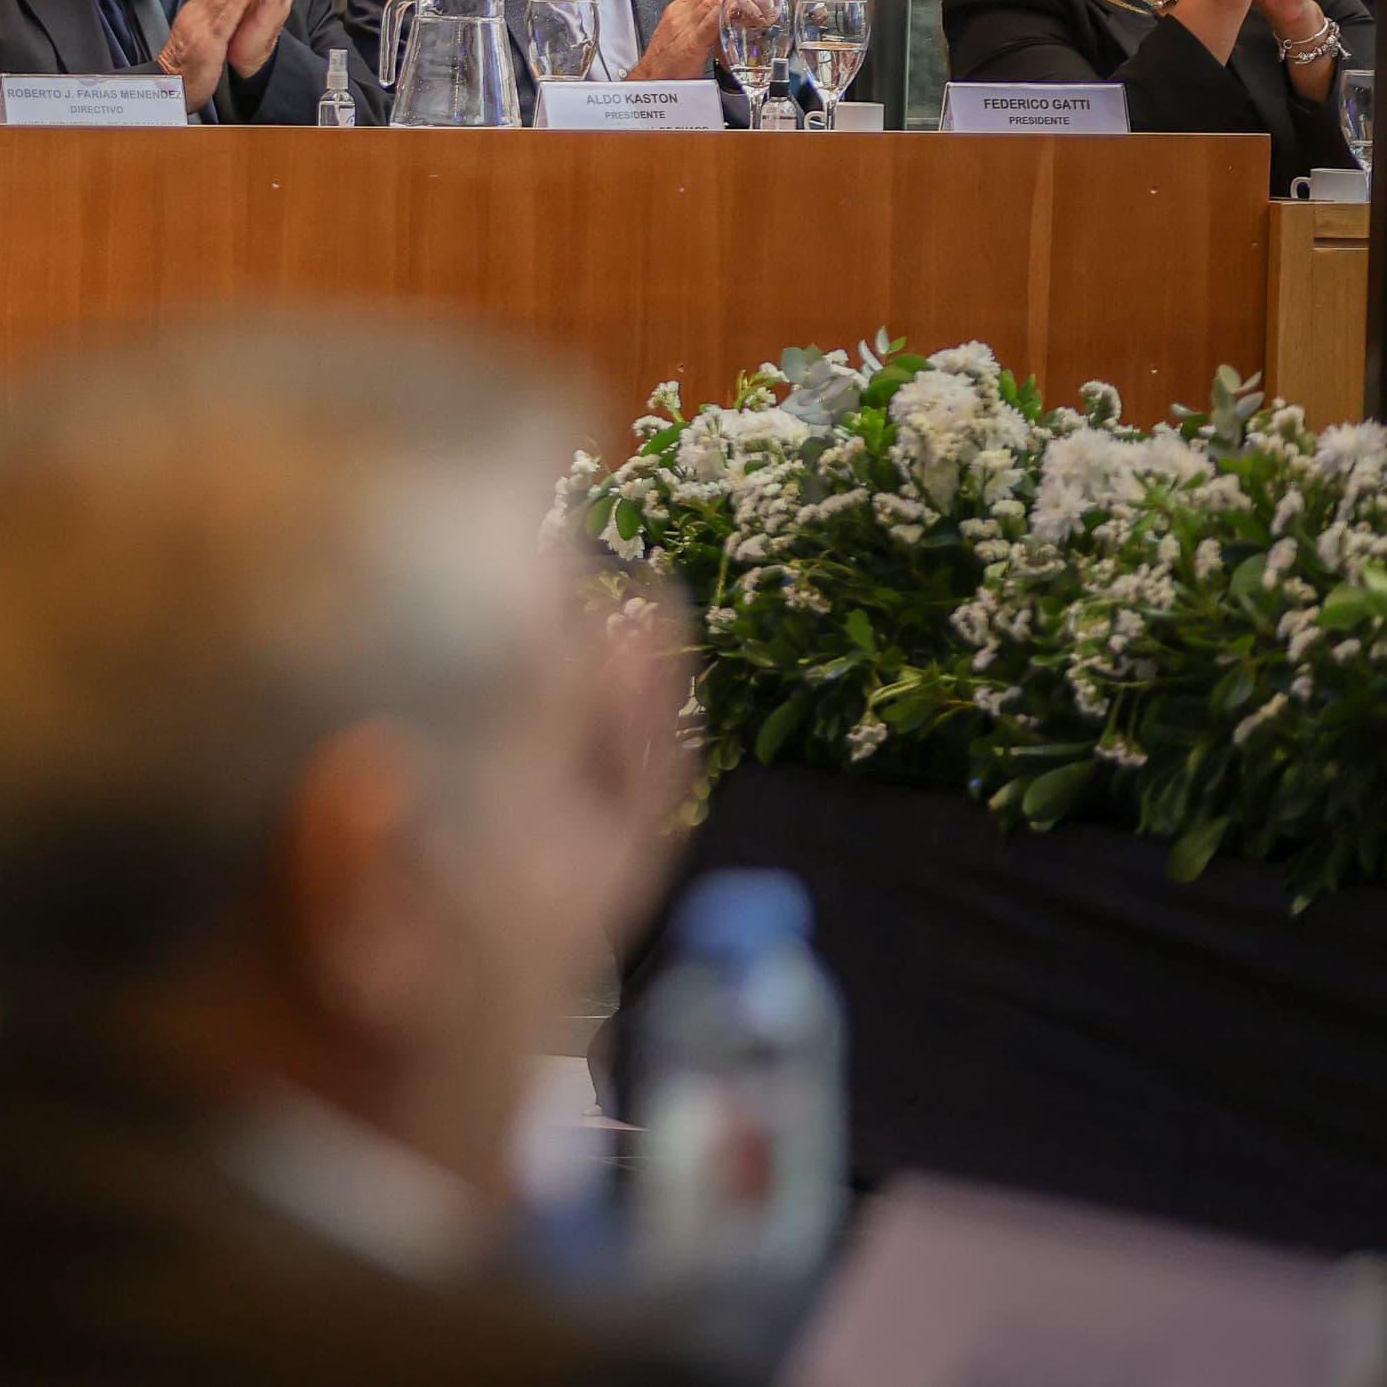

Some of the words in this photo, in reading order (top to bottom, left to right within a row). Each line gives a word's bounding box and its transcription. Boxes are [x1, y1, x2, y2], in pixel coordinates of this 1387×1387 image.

[7, 88, 62, 100] ROBERTO
[64, 89, 74, 100] J.
[77, 89, 118, 100] FARIAS
[120, 89, 183, 100] MENENDEZ
[586, 93, 622, 105] ALDO
[625, 93, 678, 104] KASTON
[70, 105, 124, 115] DIRECTIVO
[983, 98, 1050, 110] FEDERICO
[1052, 98, 1091, 111] GATTI
[604, 110, 667, 120] PRESIDENTE
[1008, 115, 1071, 126] PRESIDENTE
